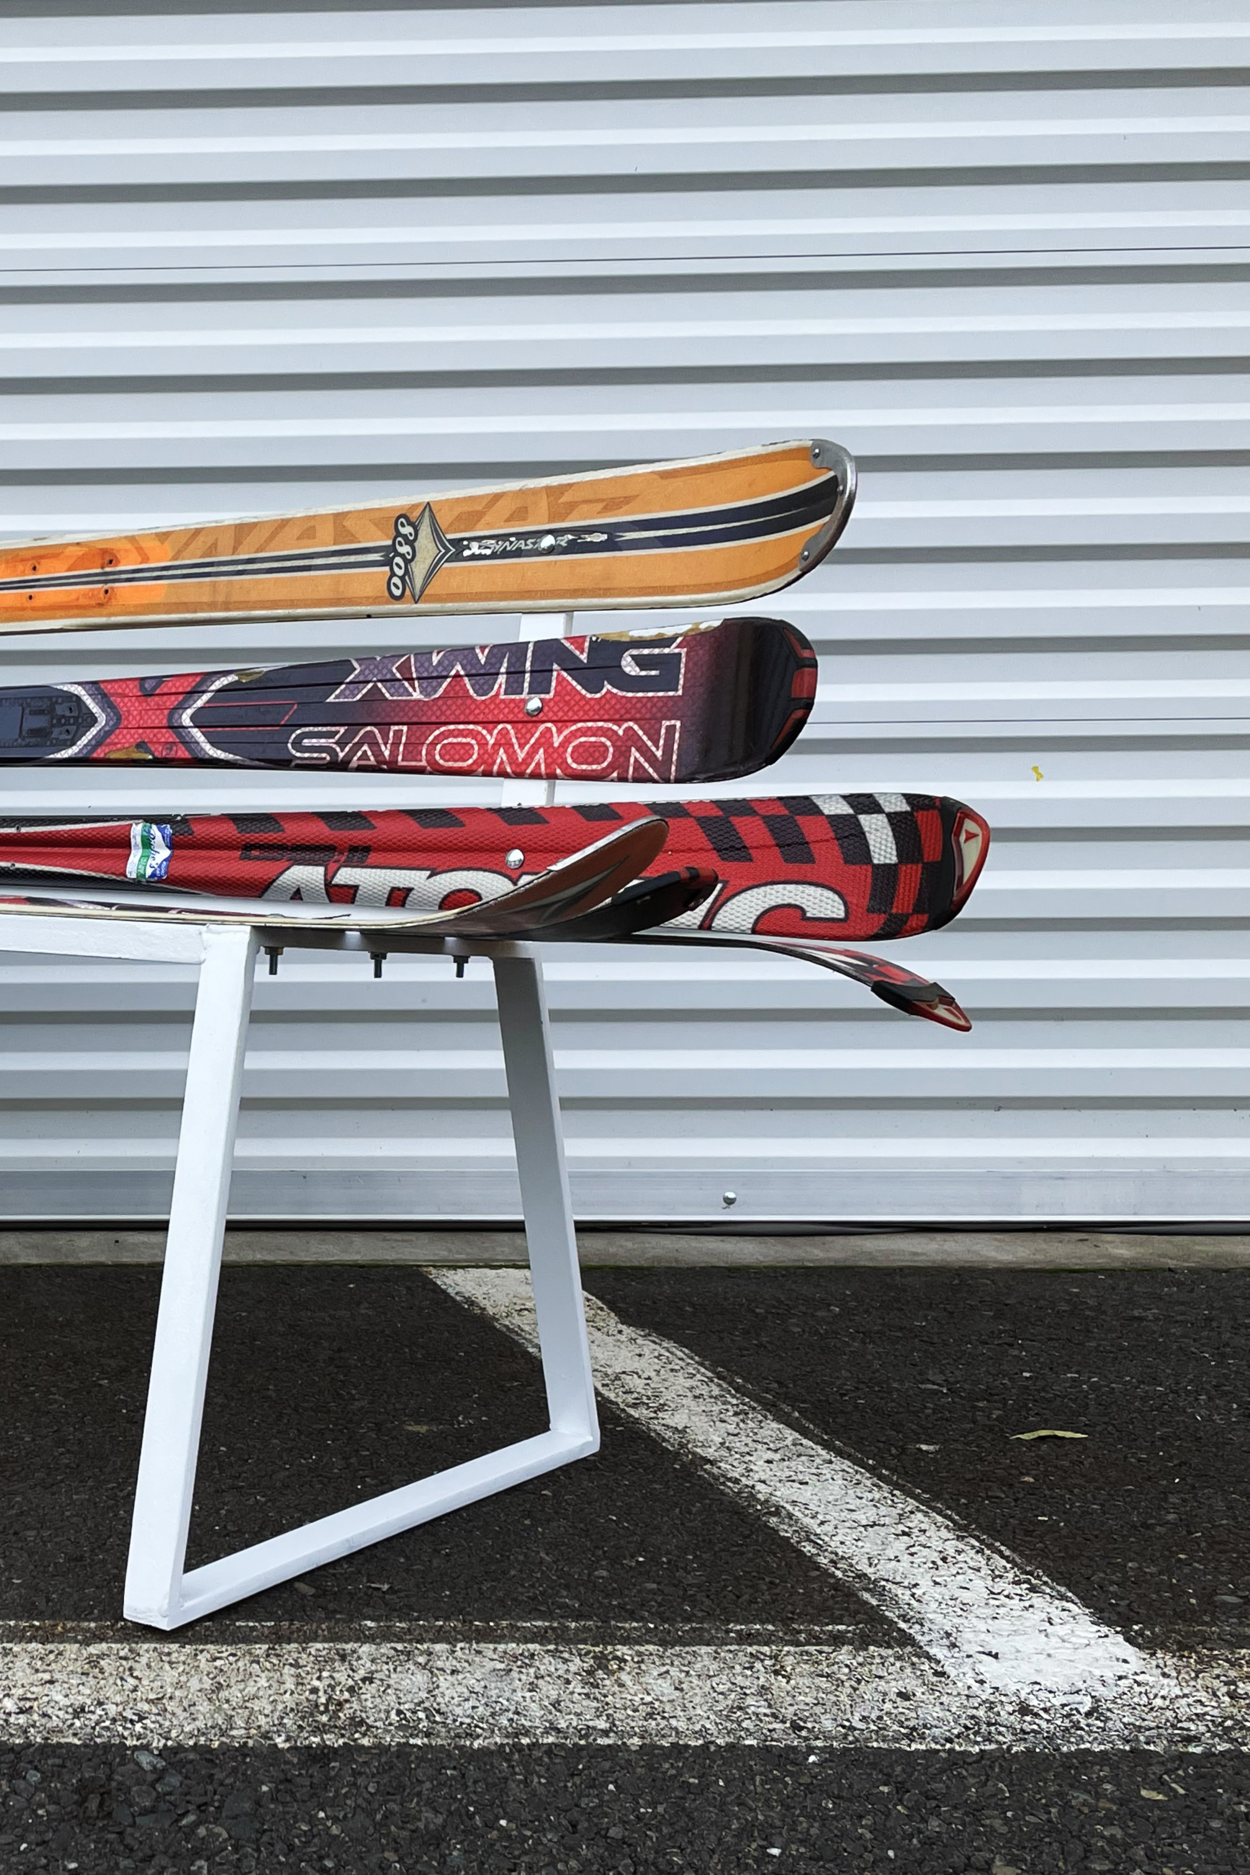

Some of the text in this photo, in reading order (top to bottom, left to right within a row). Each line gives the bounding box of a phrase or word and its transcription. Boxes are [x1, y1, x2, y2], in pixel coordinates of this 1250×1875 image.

[387, 514, 417, 599] 8800
[327, 634, 687, 702] XWING
[287, 720, 681, 783] SALOMON
